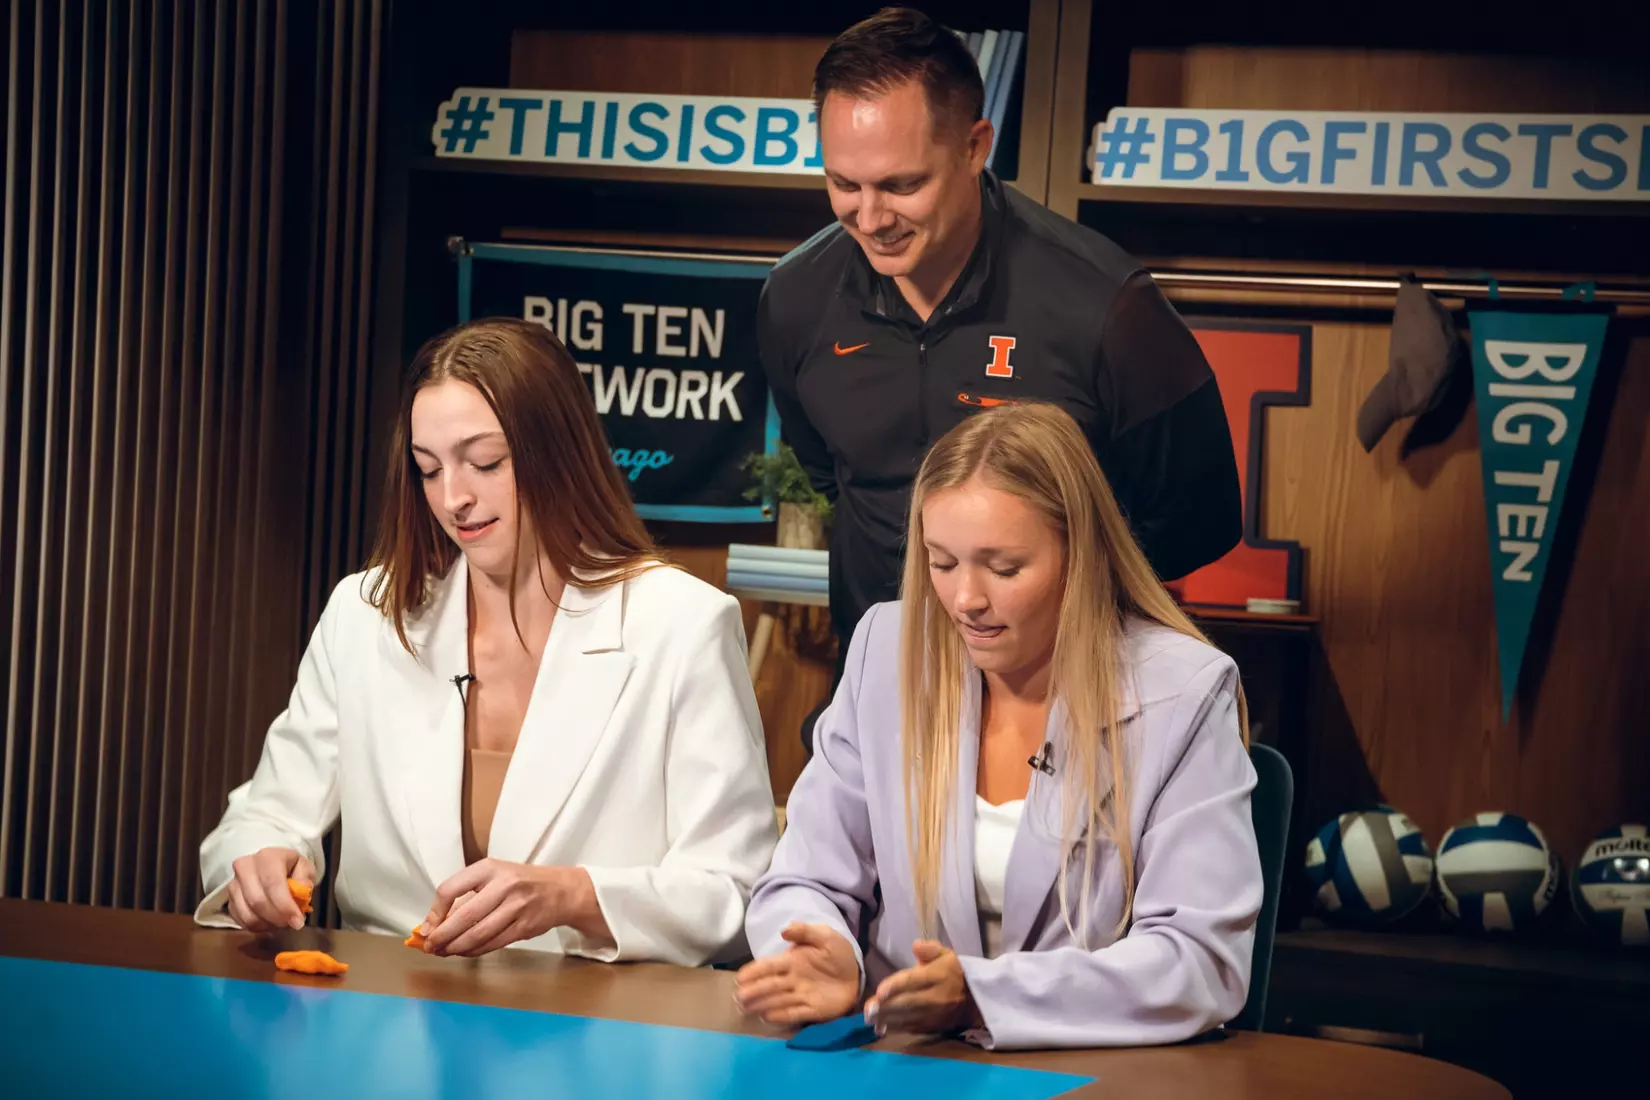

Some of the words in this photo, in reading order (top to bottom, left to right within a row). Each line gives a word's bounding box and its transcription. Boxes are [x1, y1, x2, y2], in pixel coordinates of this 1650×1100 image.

[1096, 117, 1650, 191] #B1GFIRSTS
[524, 296, 603, 351] BIG
[622, 303, 725, 358] TEN
[986, 336, 1016, 377] I
[576, 362, 744, 421] WORK
[1484, 340, 1587, 445] BIG
[1494, 460, 1560, 581] TEN
